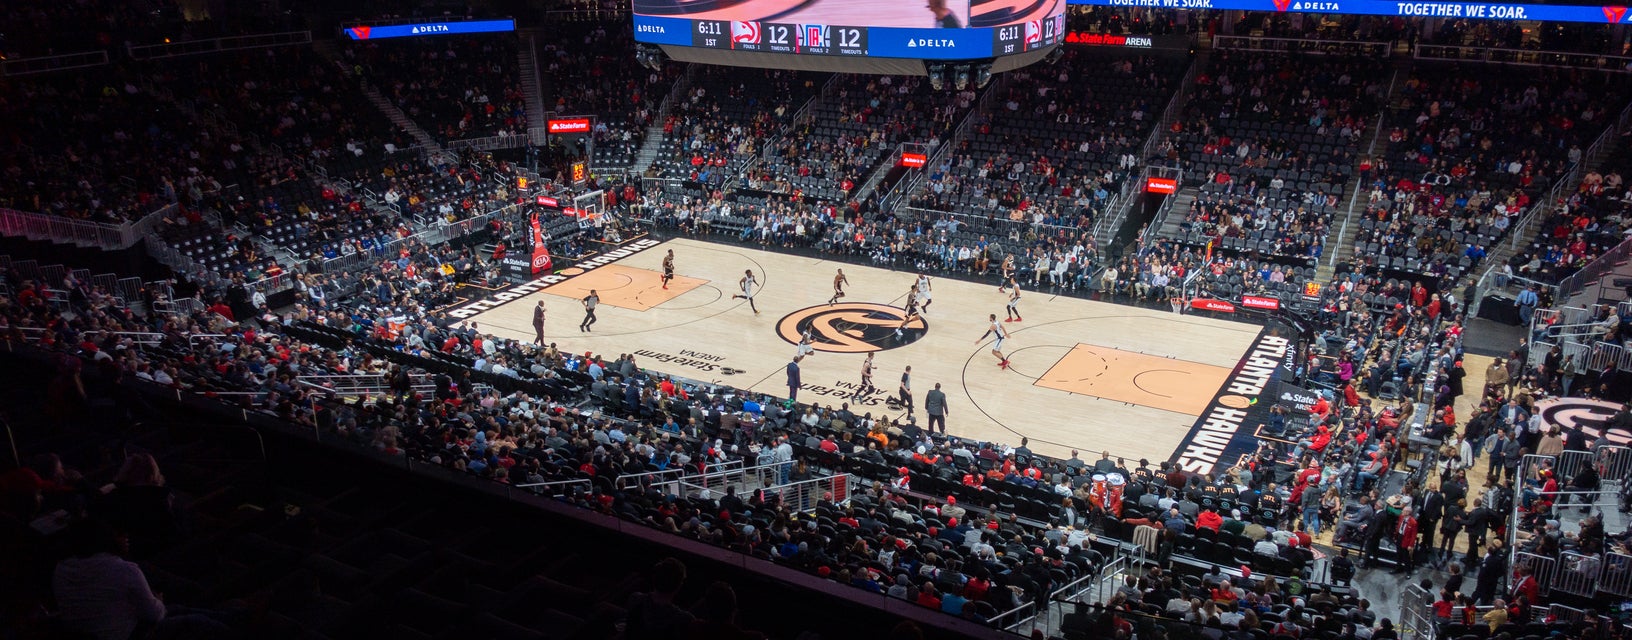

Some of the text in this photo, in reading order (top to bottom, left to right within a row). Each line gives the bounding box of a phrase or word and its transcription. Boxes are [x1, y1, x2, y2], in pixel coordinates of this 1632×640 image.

[1304, 2, 1339, 10] DELTA
[1397, 2, 1528, 19] TOGETHER WE SOAR.
[420, 25, 449, 33] DELTA
[642, 25, 665, 34] DELTA
[698, 21, 722, 35] 6:11
[768, 25, 789, 44] 12
[999, 26, 1019, 41] 6:11
[1044, 20, 1054, 39] 12
[705, 38, 717, 47] 1ST
[838, 28, 861, 48] 12
[919, 39, 956, 48] DELTA
[1125, 37, 1152, 47] ARENA
[1004, 44, 1015, 53] 1ST
[535, 257, 548, 266] KIA
[577, 240, 660, 269] HAWKS
[450, 273, 569, 319] ATLANTA
[679, 349, 726, 361] ARENA
[1283, 344, 1297, 371] xfinity
[1226, 335, 1290, 396] ATLANTA
[834, 380, 888, 396] AENA
[1176, 406, 1248, 475] HAWKS
